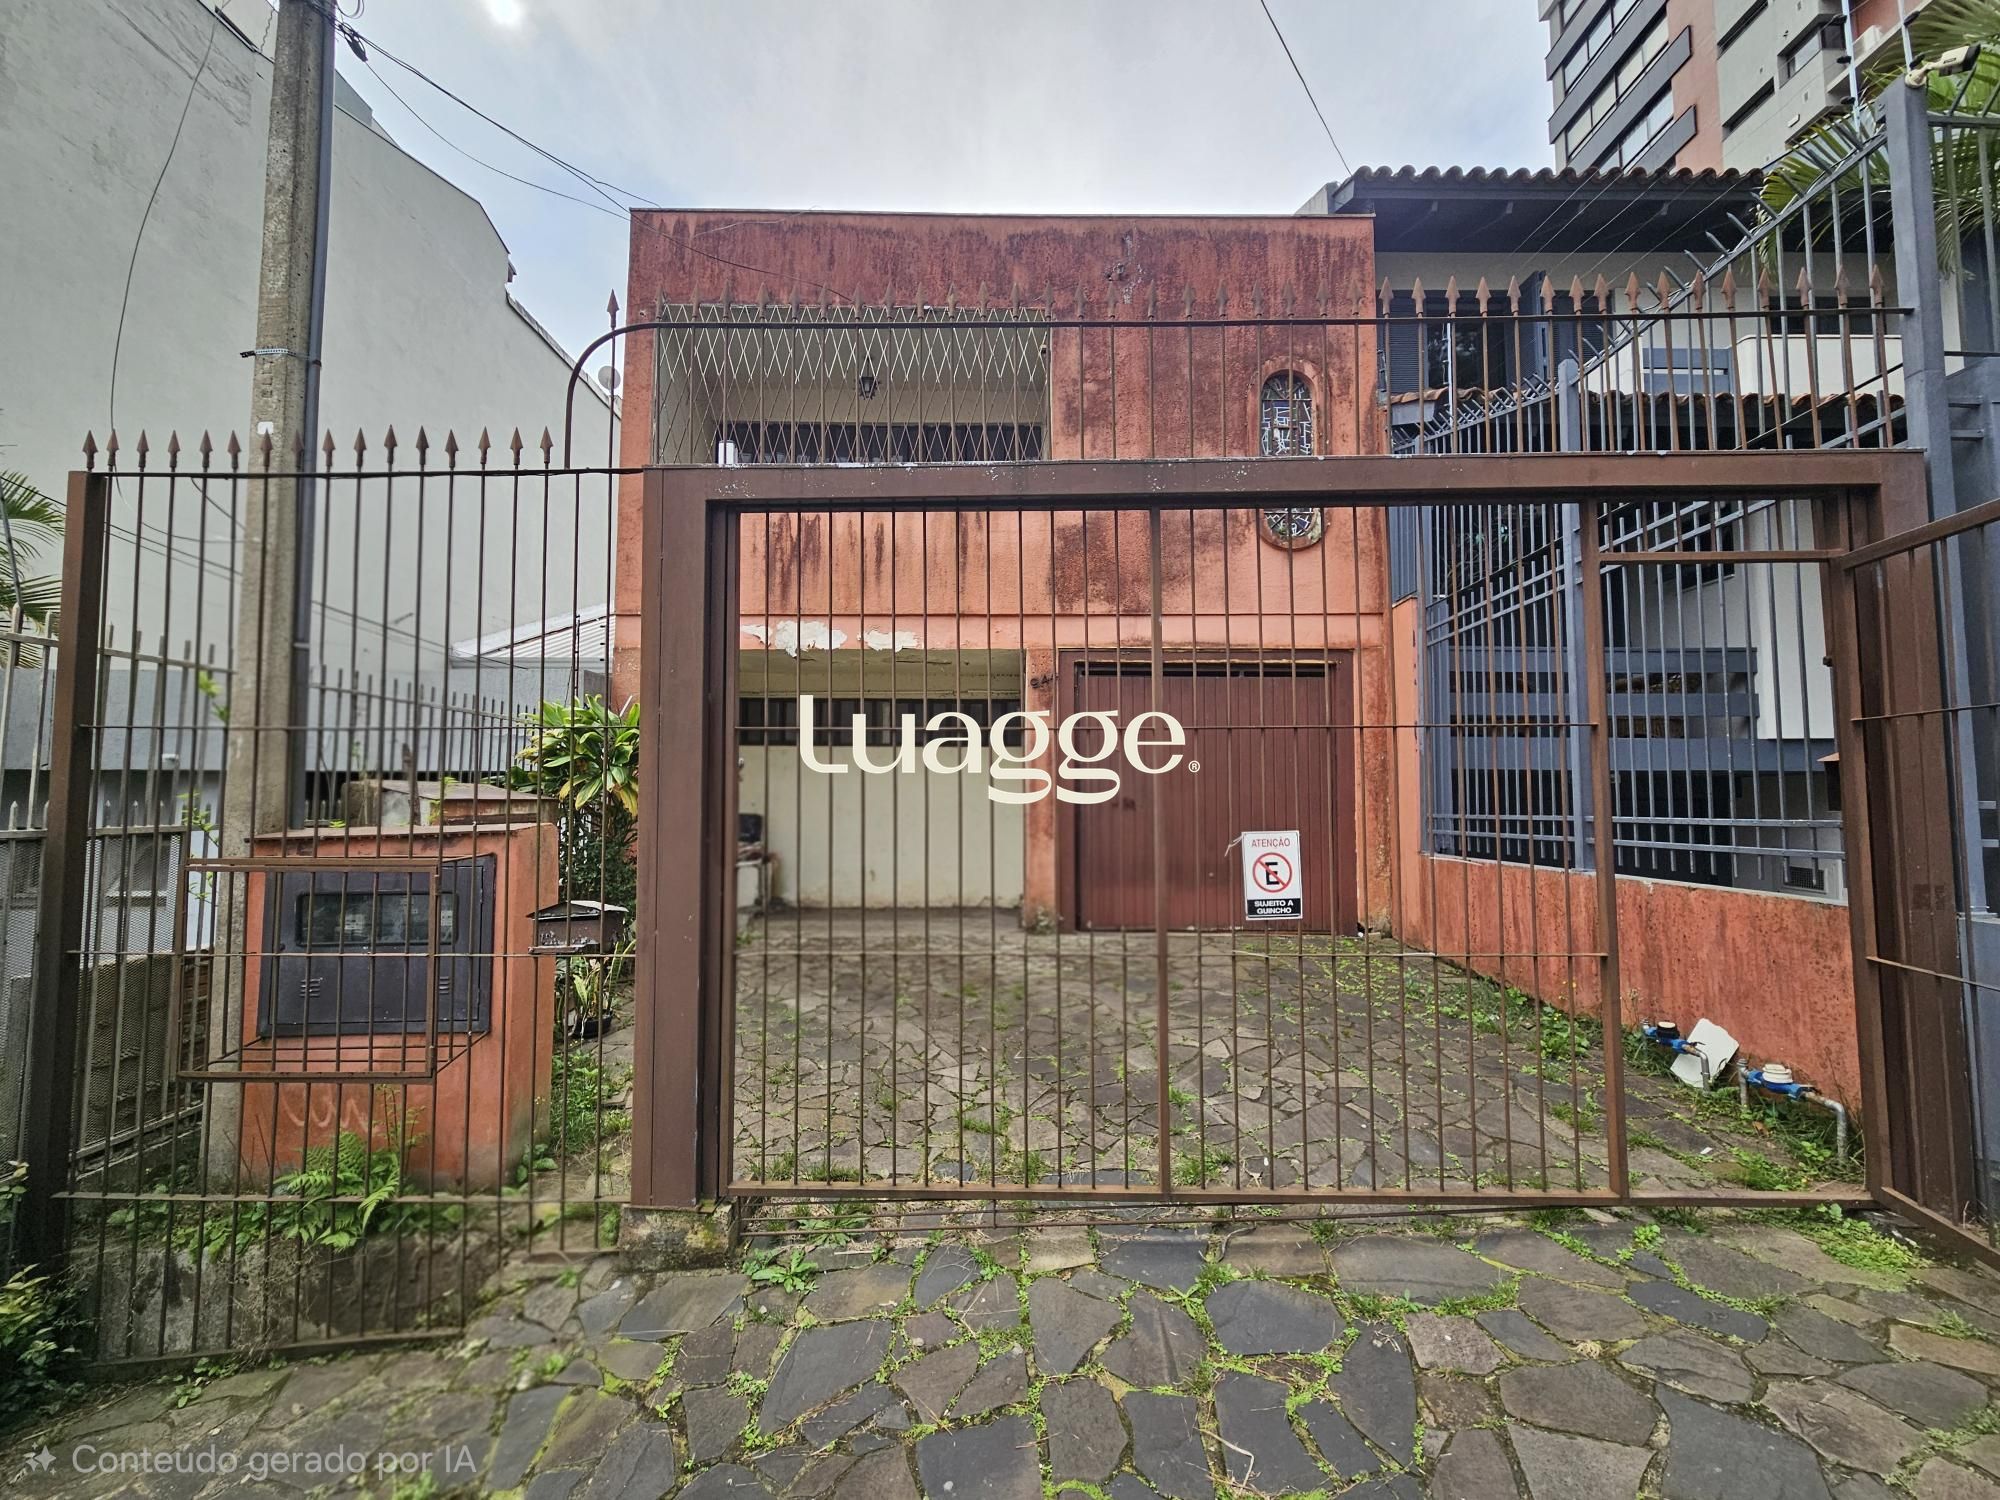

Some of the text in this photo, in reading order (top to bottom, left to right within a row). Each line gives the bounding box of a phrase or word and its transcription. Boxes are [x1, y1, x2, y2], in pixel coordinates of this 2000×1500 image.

[1251, 837, 1291, 849] ATENÇÃO
[1265, 861, 1280, 885] E
[1254, 900, 1286, 908] SUJEITO
[1256, 907, 1292, 915] QUINCHO
